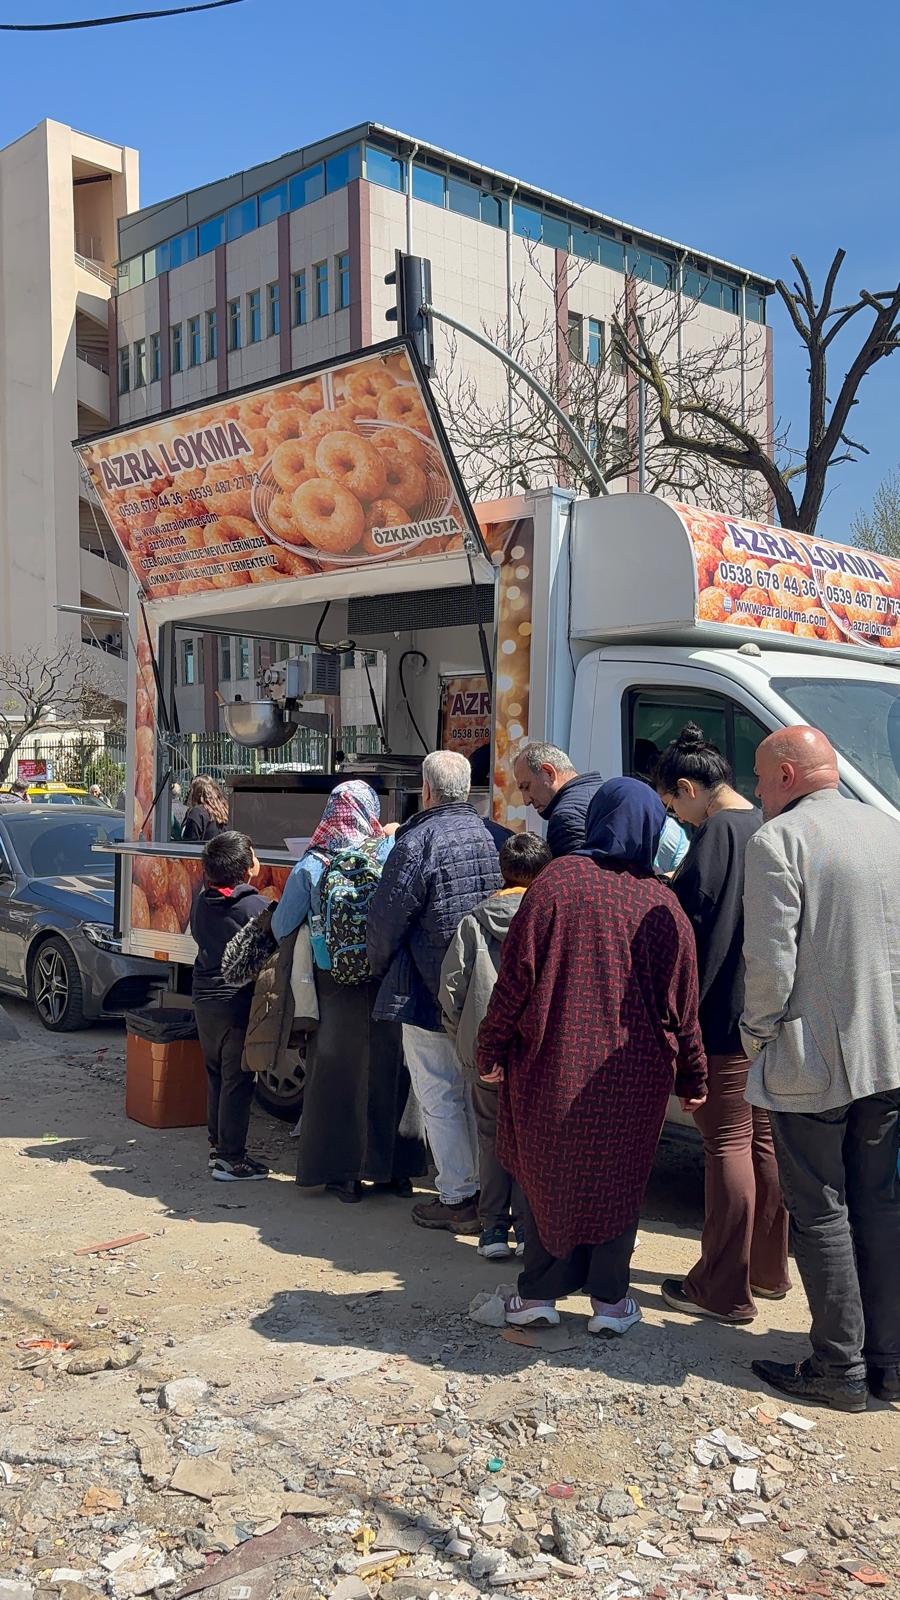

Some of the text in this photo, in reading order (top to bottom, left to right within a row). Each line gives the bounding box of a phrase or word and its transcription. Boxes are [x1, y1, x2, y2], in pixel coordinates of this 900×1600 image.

[100, 422, 252, 490] AZRA LOKMA
[119, 501, 141, 517] 0538
[141, 498, 158, 513] 678
[158, 495, 171, 508] 44
[170, 492, 183, 505] 36
[190, 486, 213, 501] 0539
[215, 480, 231, 493] 487
[234, 477, 246, 490] 27
[247, 472, 262, 486] 73
[141, 512, 220, 537] www.azralokma.com
[373, 517, 460, 545] ÖZKAN USTA
[148, 534, 187, 551] azralokma
[726, 523, 890, 583] AZRA LOKMA
[147, 573, 170, 586] LOKMA
[226, 552, 278, 573] VERMEKTEYİZ
[720, 563, 752, 585] 0538
[756, 571, 779, 590] 678
[783, 577, 799, 595] 44
[802, 580, 817, 597] 36
[826, 586, 852, 605] 0539
[855, 593, 872, 609] 487
[875, 596, 887, 612] 27
[889, 600, 900, 616] 73
[735, 600, 827, 627] www.azralokma.com
[853, 619, 892, 637] azralokma
[452, 728, 490, 738] 0538 678
